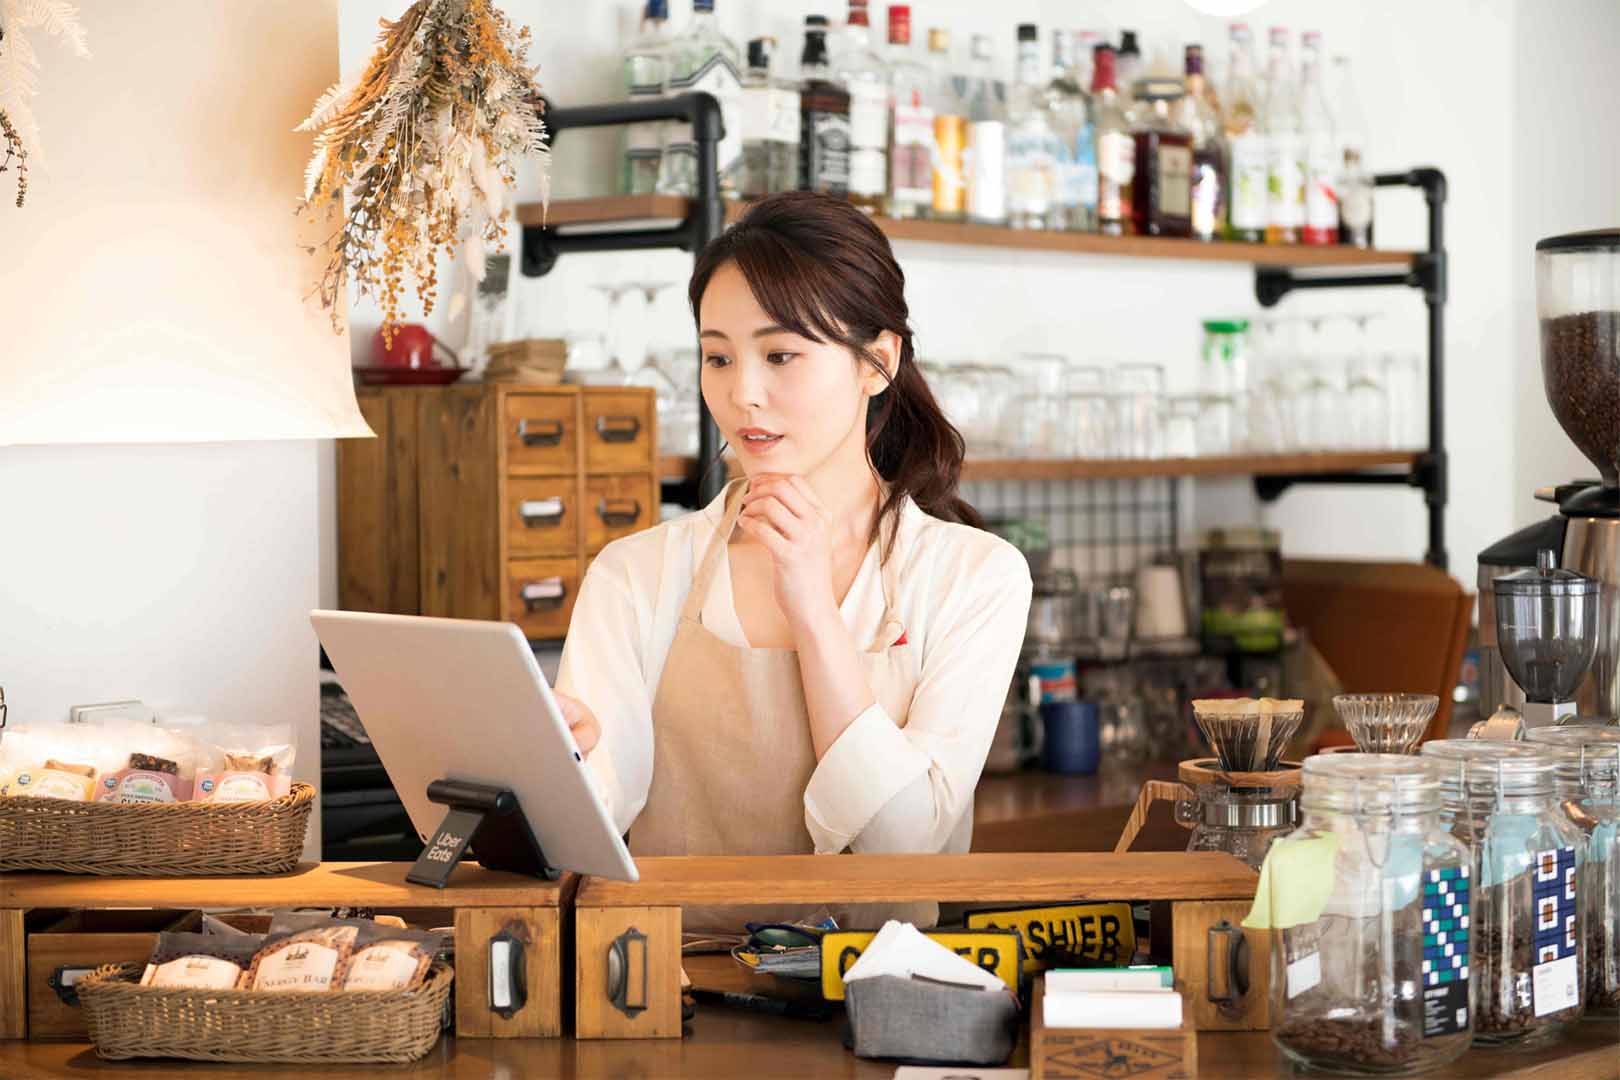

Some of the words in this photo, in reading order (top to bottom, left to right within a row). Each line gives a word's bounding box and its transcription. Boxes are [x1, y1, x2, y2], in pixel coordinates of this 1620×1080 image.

[436, 832, 462, 848] Uber
[427, 846, 453, 862] Eats
[987, 914, 1121, 962] SHIER
